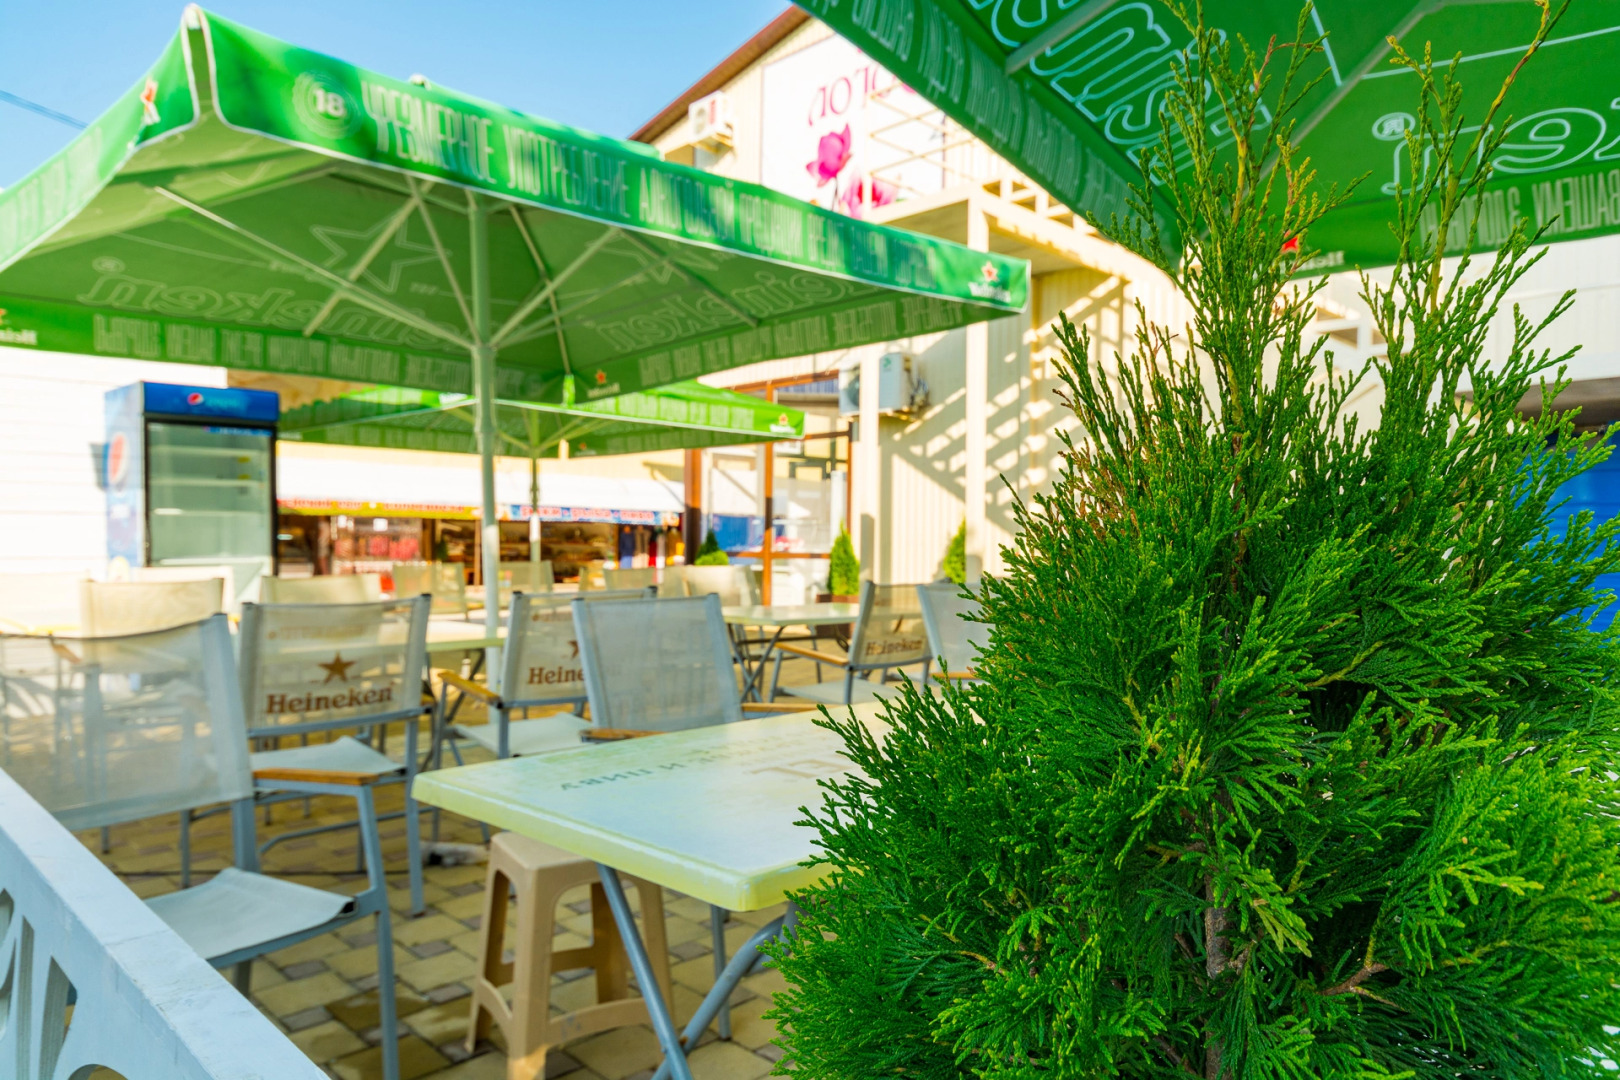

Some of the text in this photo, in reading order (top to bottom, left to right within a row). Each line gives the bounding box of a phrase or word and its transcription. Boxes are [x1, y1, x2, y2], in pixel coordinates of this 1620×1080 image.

[311, 87, 347, 118] 18
[526, 665, 586, 685] Heine
[265, 686, 394, 714] Heineken
